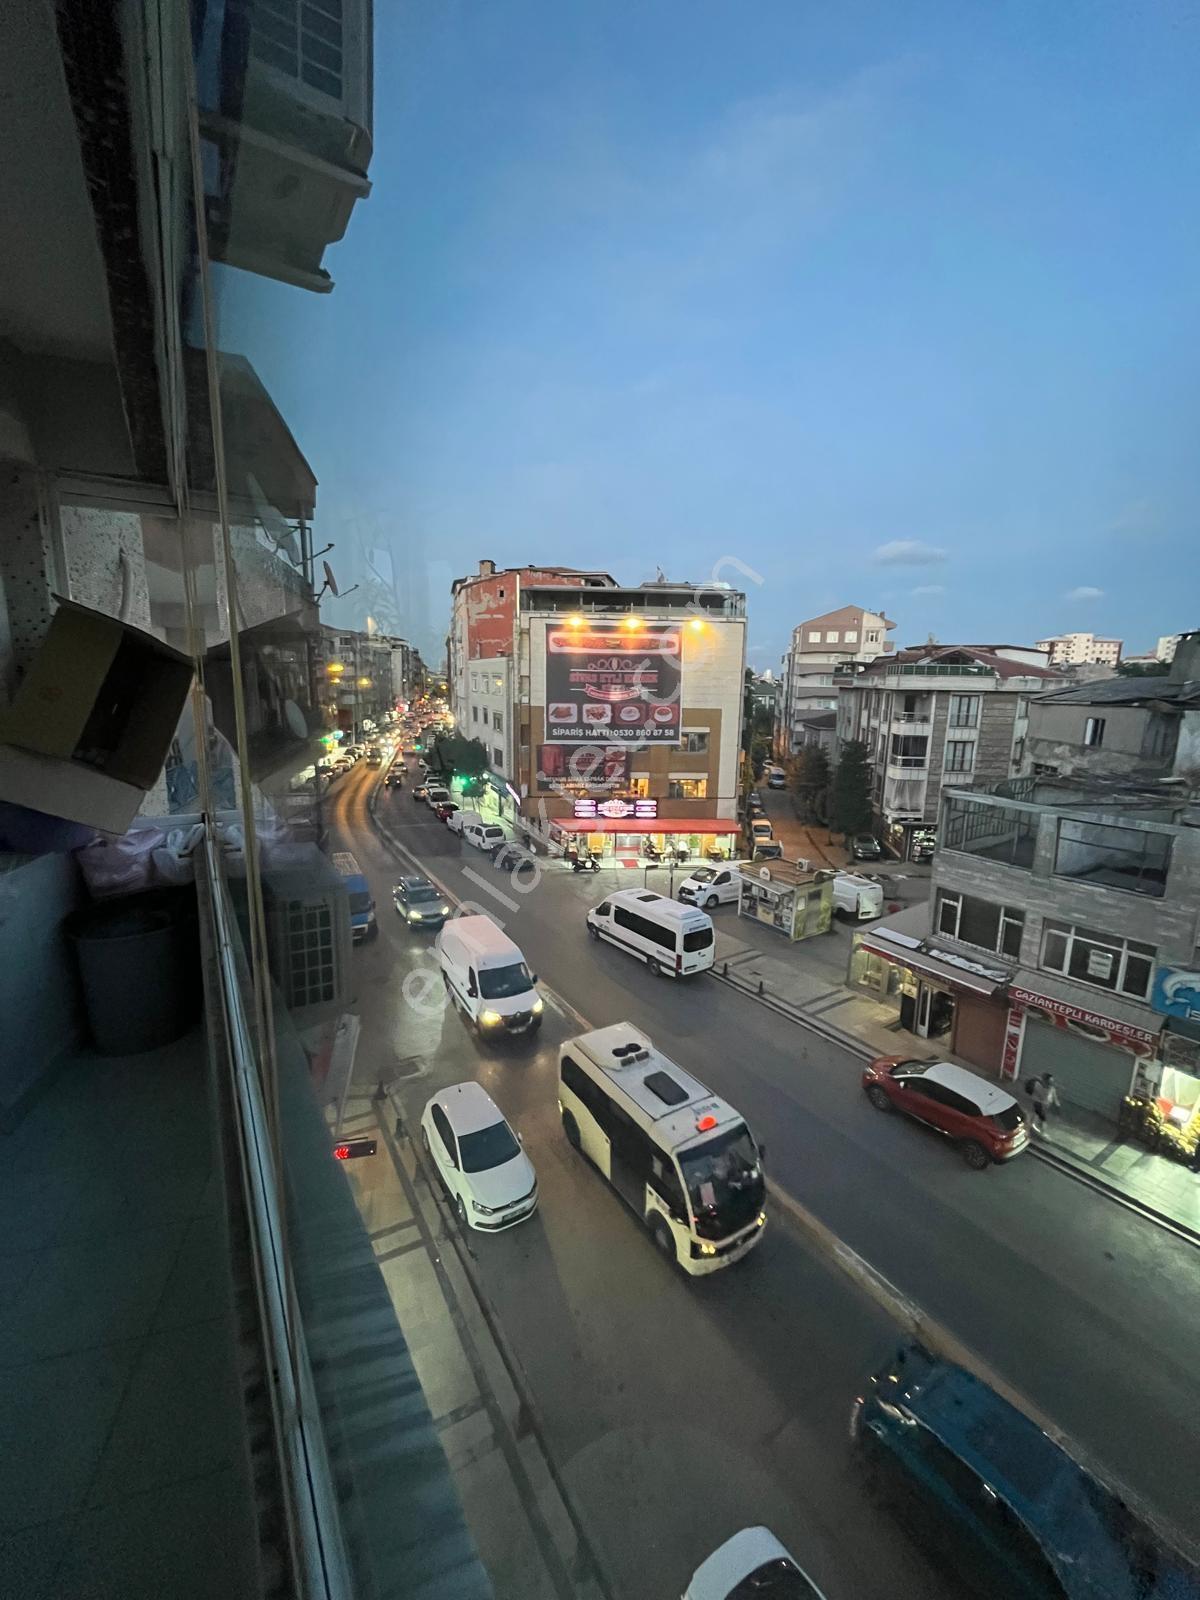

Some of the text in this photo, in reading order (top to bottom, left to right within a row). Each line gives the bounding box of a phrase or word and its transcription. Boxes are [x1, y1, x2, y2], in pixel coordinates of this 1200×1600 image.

[552, 727, 583, 737] SİPARİŞ
[636, 729, 651, 737] 860
[653, 729, 663, 737] 87
[664, 729, 674, 737] 58
